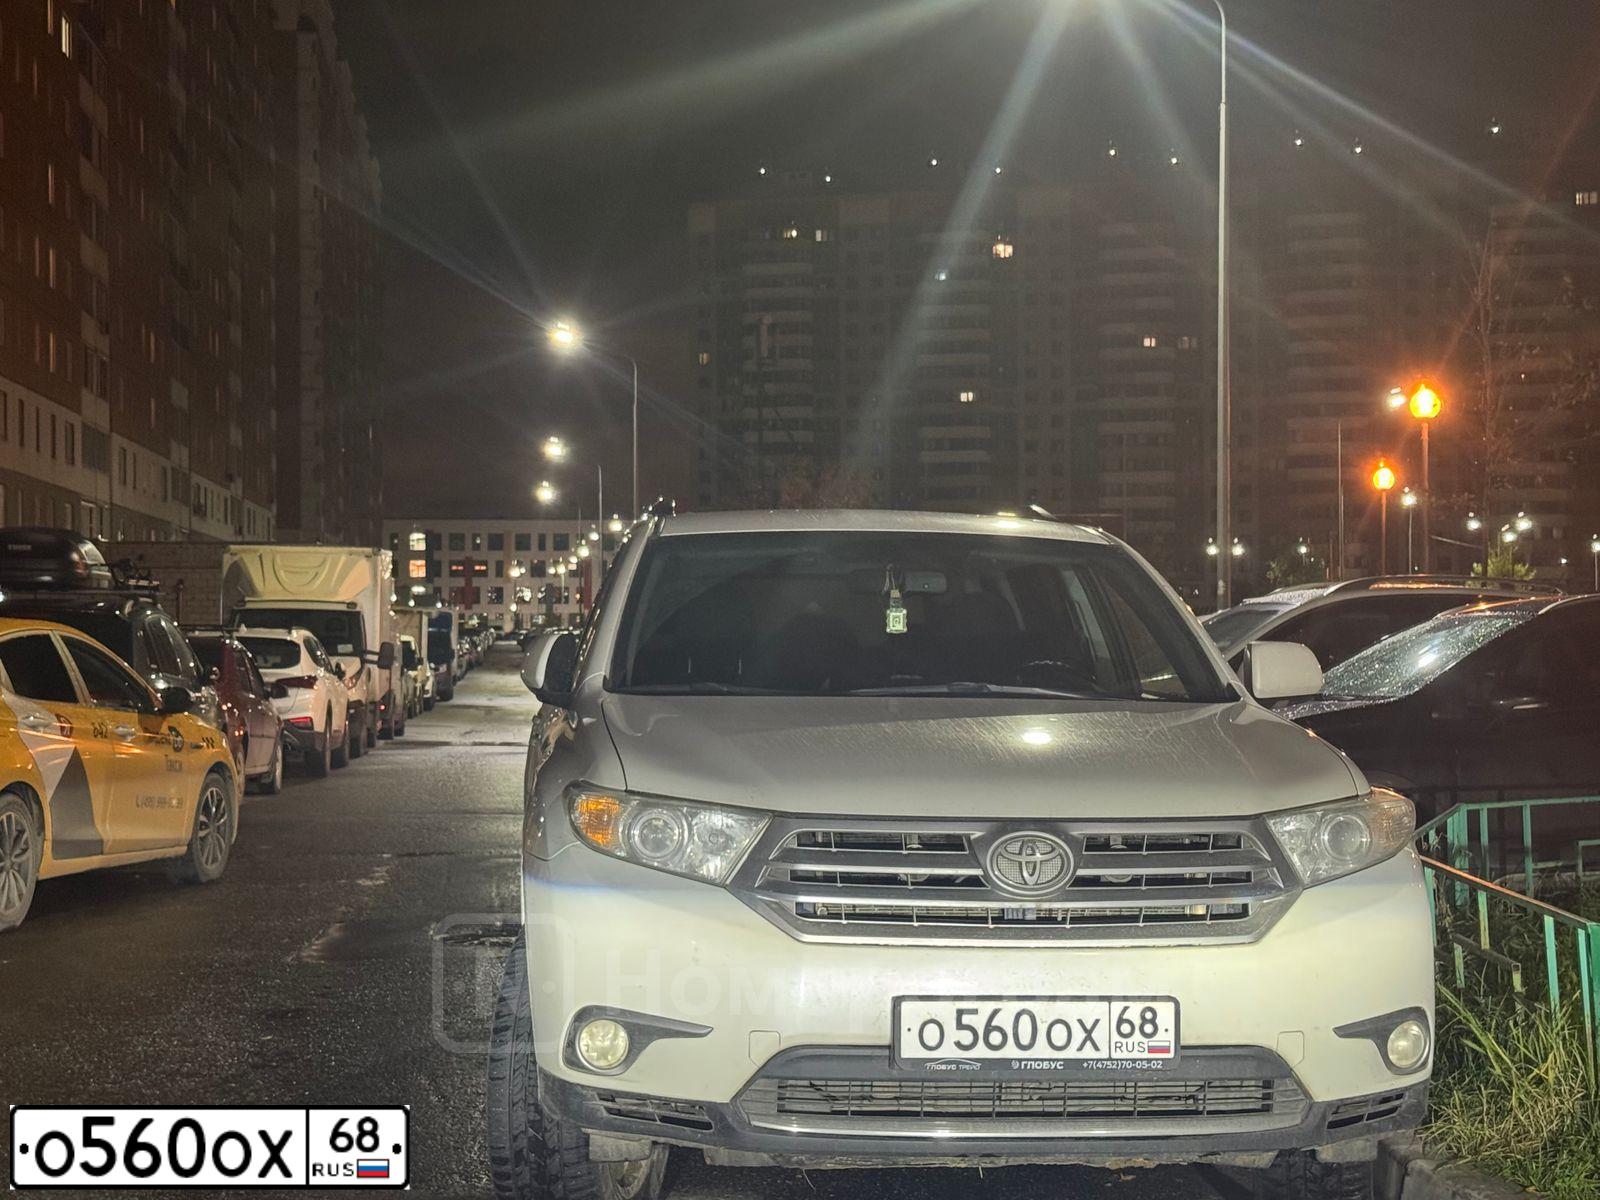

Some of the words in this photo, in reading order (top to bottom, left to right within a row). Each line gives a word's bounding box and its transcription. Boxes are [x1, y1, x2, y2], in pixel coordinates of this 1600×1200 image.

[1115, 1006, 1159, 1039] 68
[918, 1008, 1101, 1052] О560ОХ
[1114, 1041, 1146, 1053] RUS
[1021, 1060, 1064, 1070] ГЛОБУС
[1082, 1060, 1163, 1070] +7(4752)70-05-02
